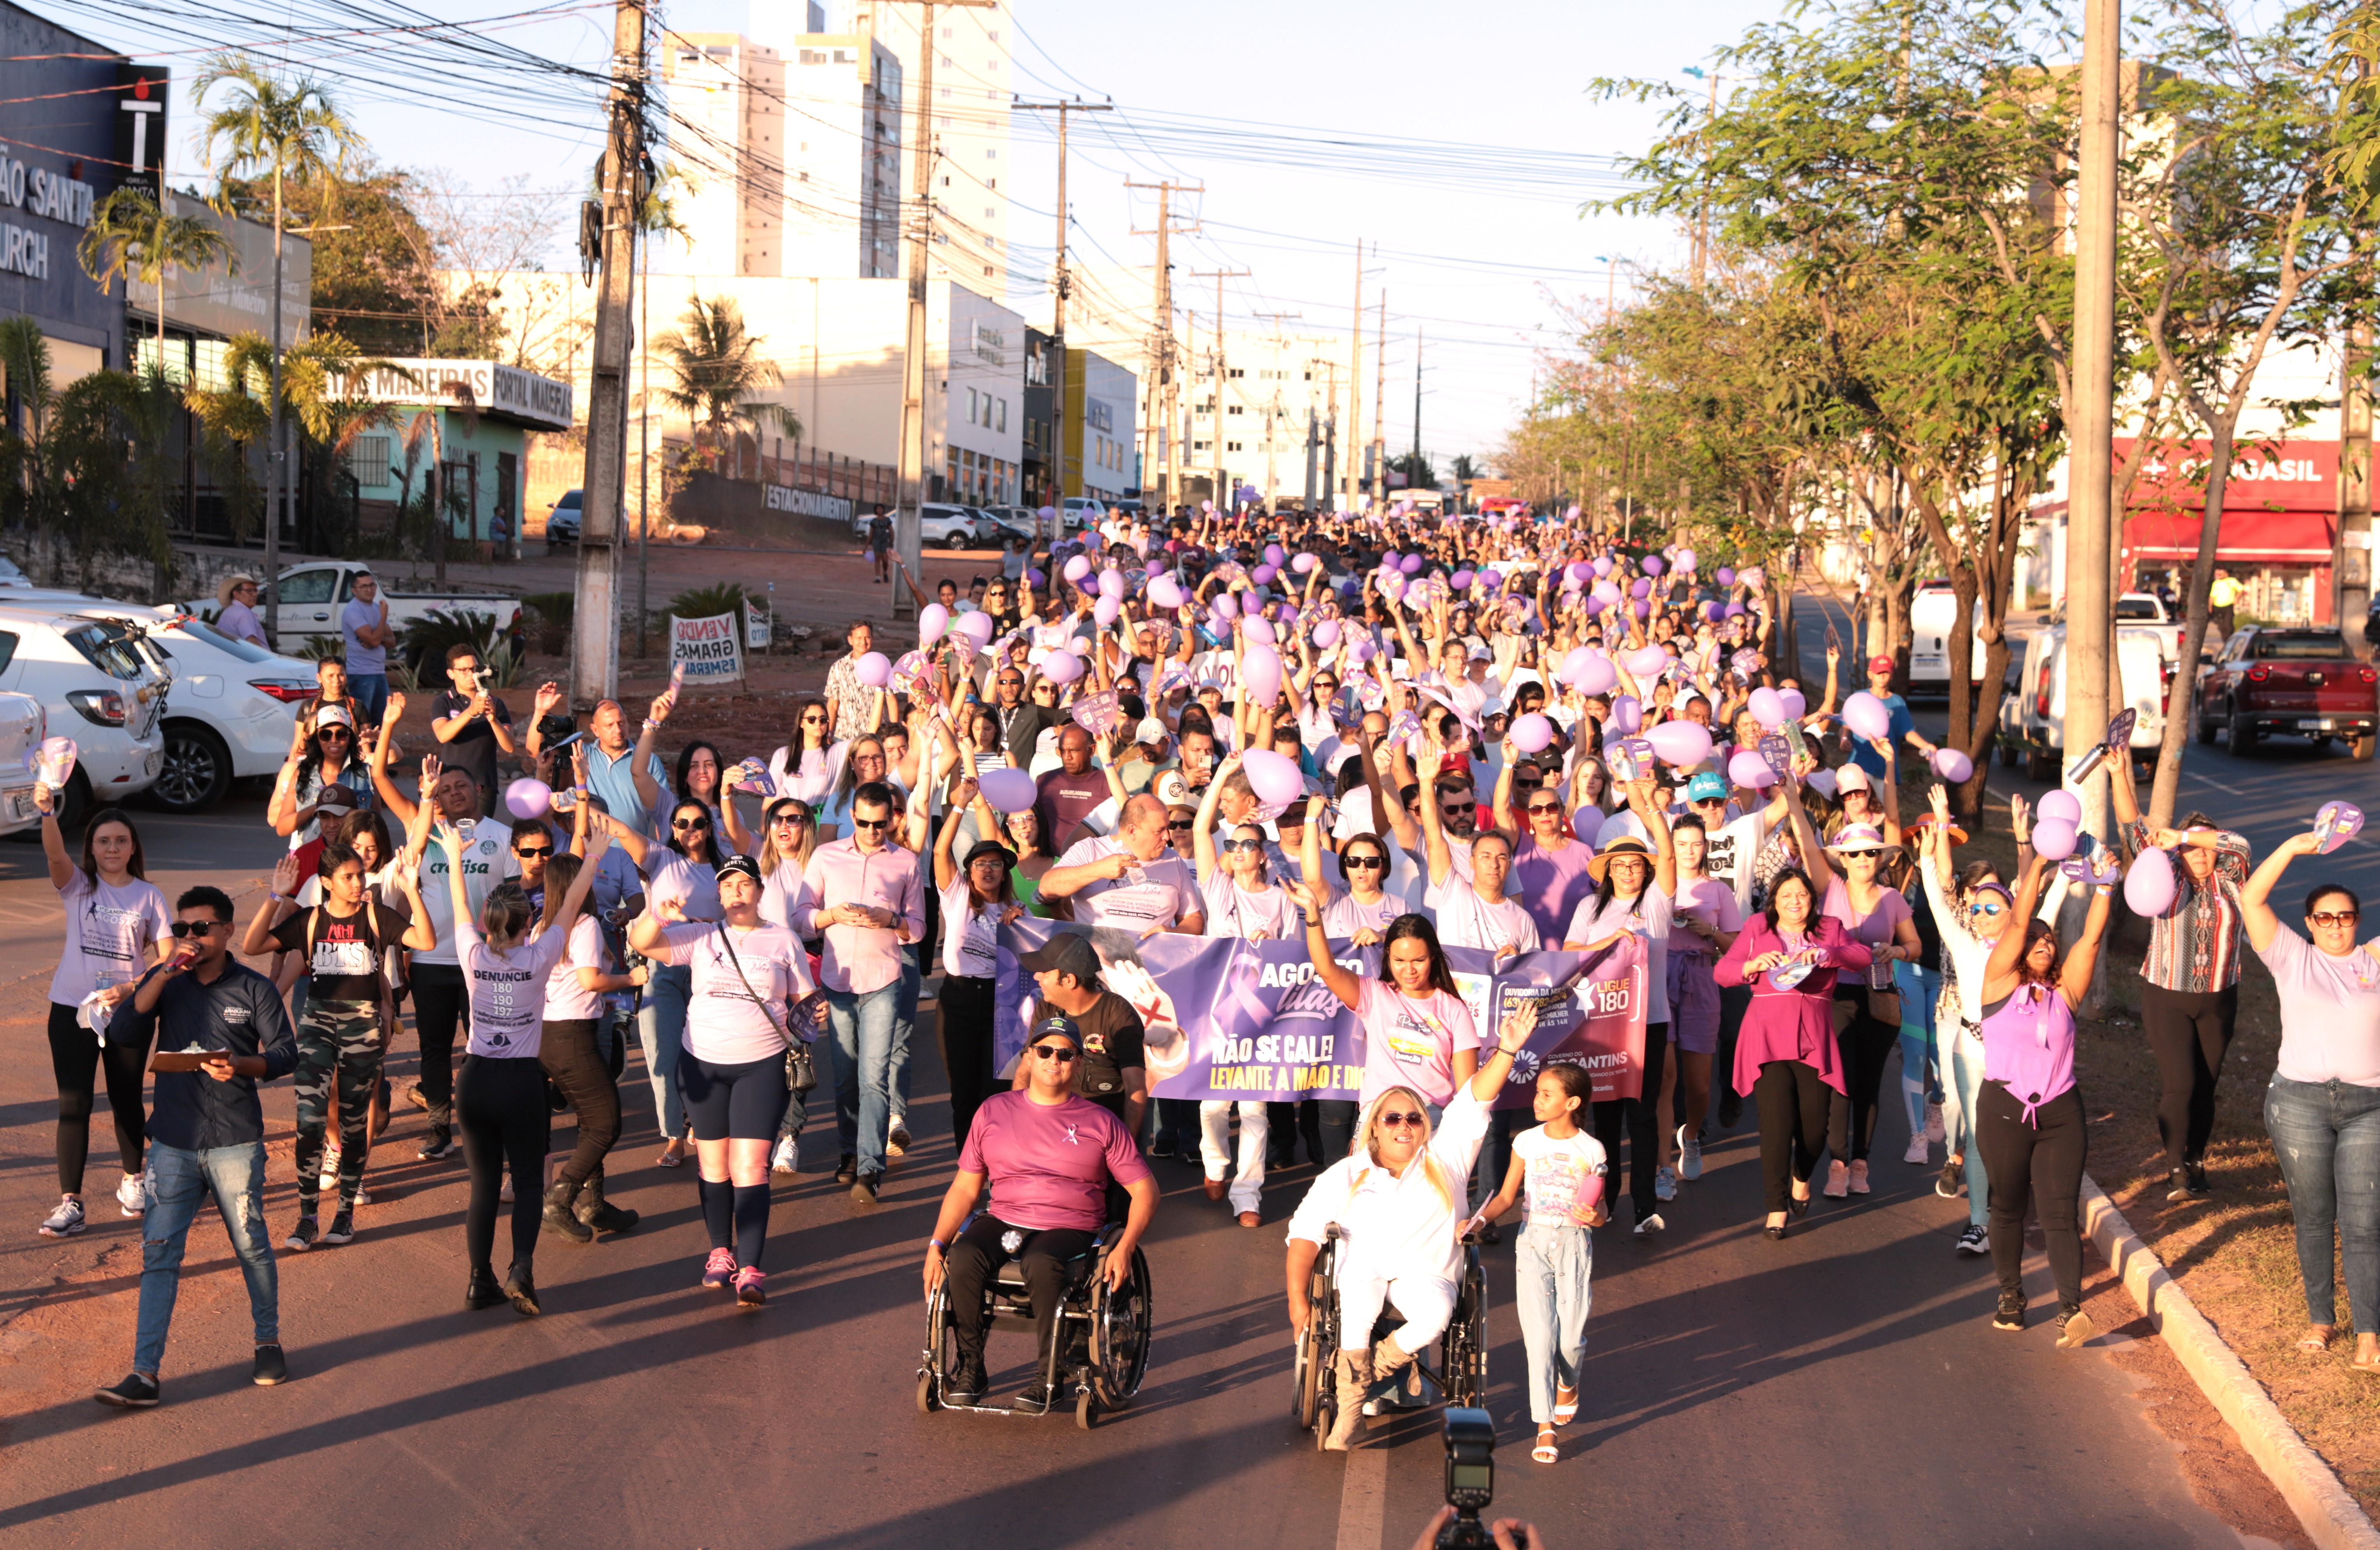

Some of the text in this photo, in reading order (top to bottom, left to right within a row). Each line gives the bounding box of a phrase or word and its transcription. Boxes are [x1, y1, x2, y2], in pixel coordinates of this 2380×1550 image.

[28, 167, 94, 228] SANTA
[377, 367, 487, 397] MADEIRAS
[494, 368, 572, 420] FORTAL MADEIRAS
[2179, 458, 2322, 482] DGASIL
[767, 485, 851, 522] ESTACIONAMENTO
[724, 860, 748, 868] BERETTA
[96, 913, 139, 927] AGOSTO
[105, 908, 141, 918] CAMINHADA
[86, 939, 105, 948] CONTRA
[317, 941, 365, 967] BTS
[474, 970, 532, 981] DENUNCIE
[1259, 959, 1364, 988] AGOO
[492, 982, 513, 993] 180
[1505, 988, 1539, 996] OUVIDORIA
[1541, 988, 1549, 996] DA
[1597, 978, 1630, 993] LIGUE
[492, 995, 513, 1006] 190
[1504, 997, 1521, 1009] (63)
[1598, 990, 1629, 1013] 180
[493, 1006, 513, 1016] 197
[1212, 1033, 1334, 1064] NÃO SE CALE!
[1548, 1051, 1627, 1069] ANTINS
[1210, 1066, 1273, 1090] LEVANTE
[1275, 1067, 1290, 1091] A
[1293, 1062, 1330, 1091] MÃO
[1332, 1065, 1341, 1089] E
